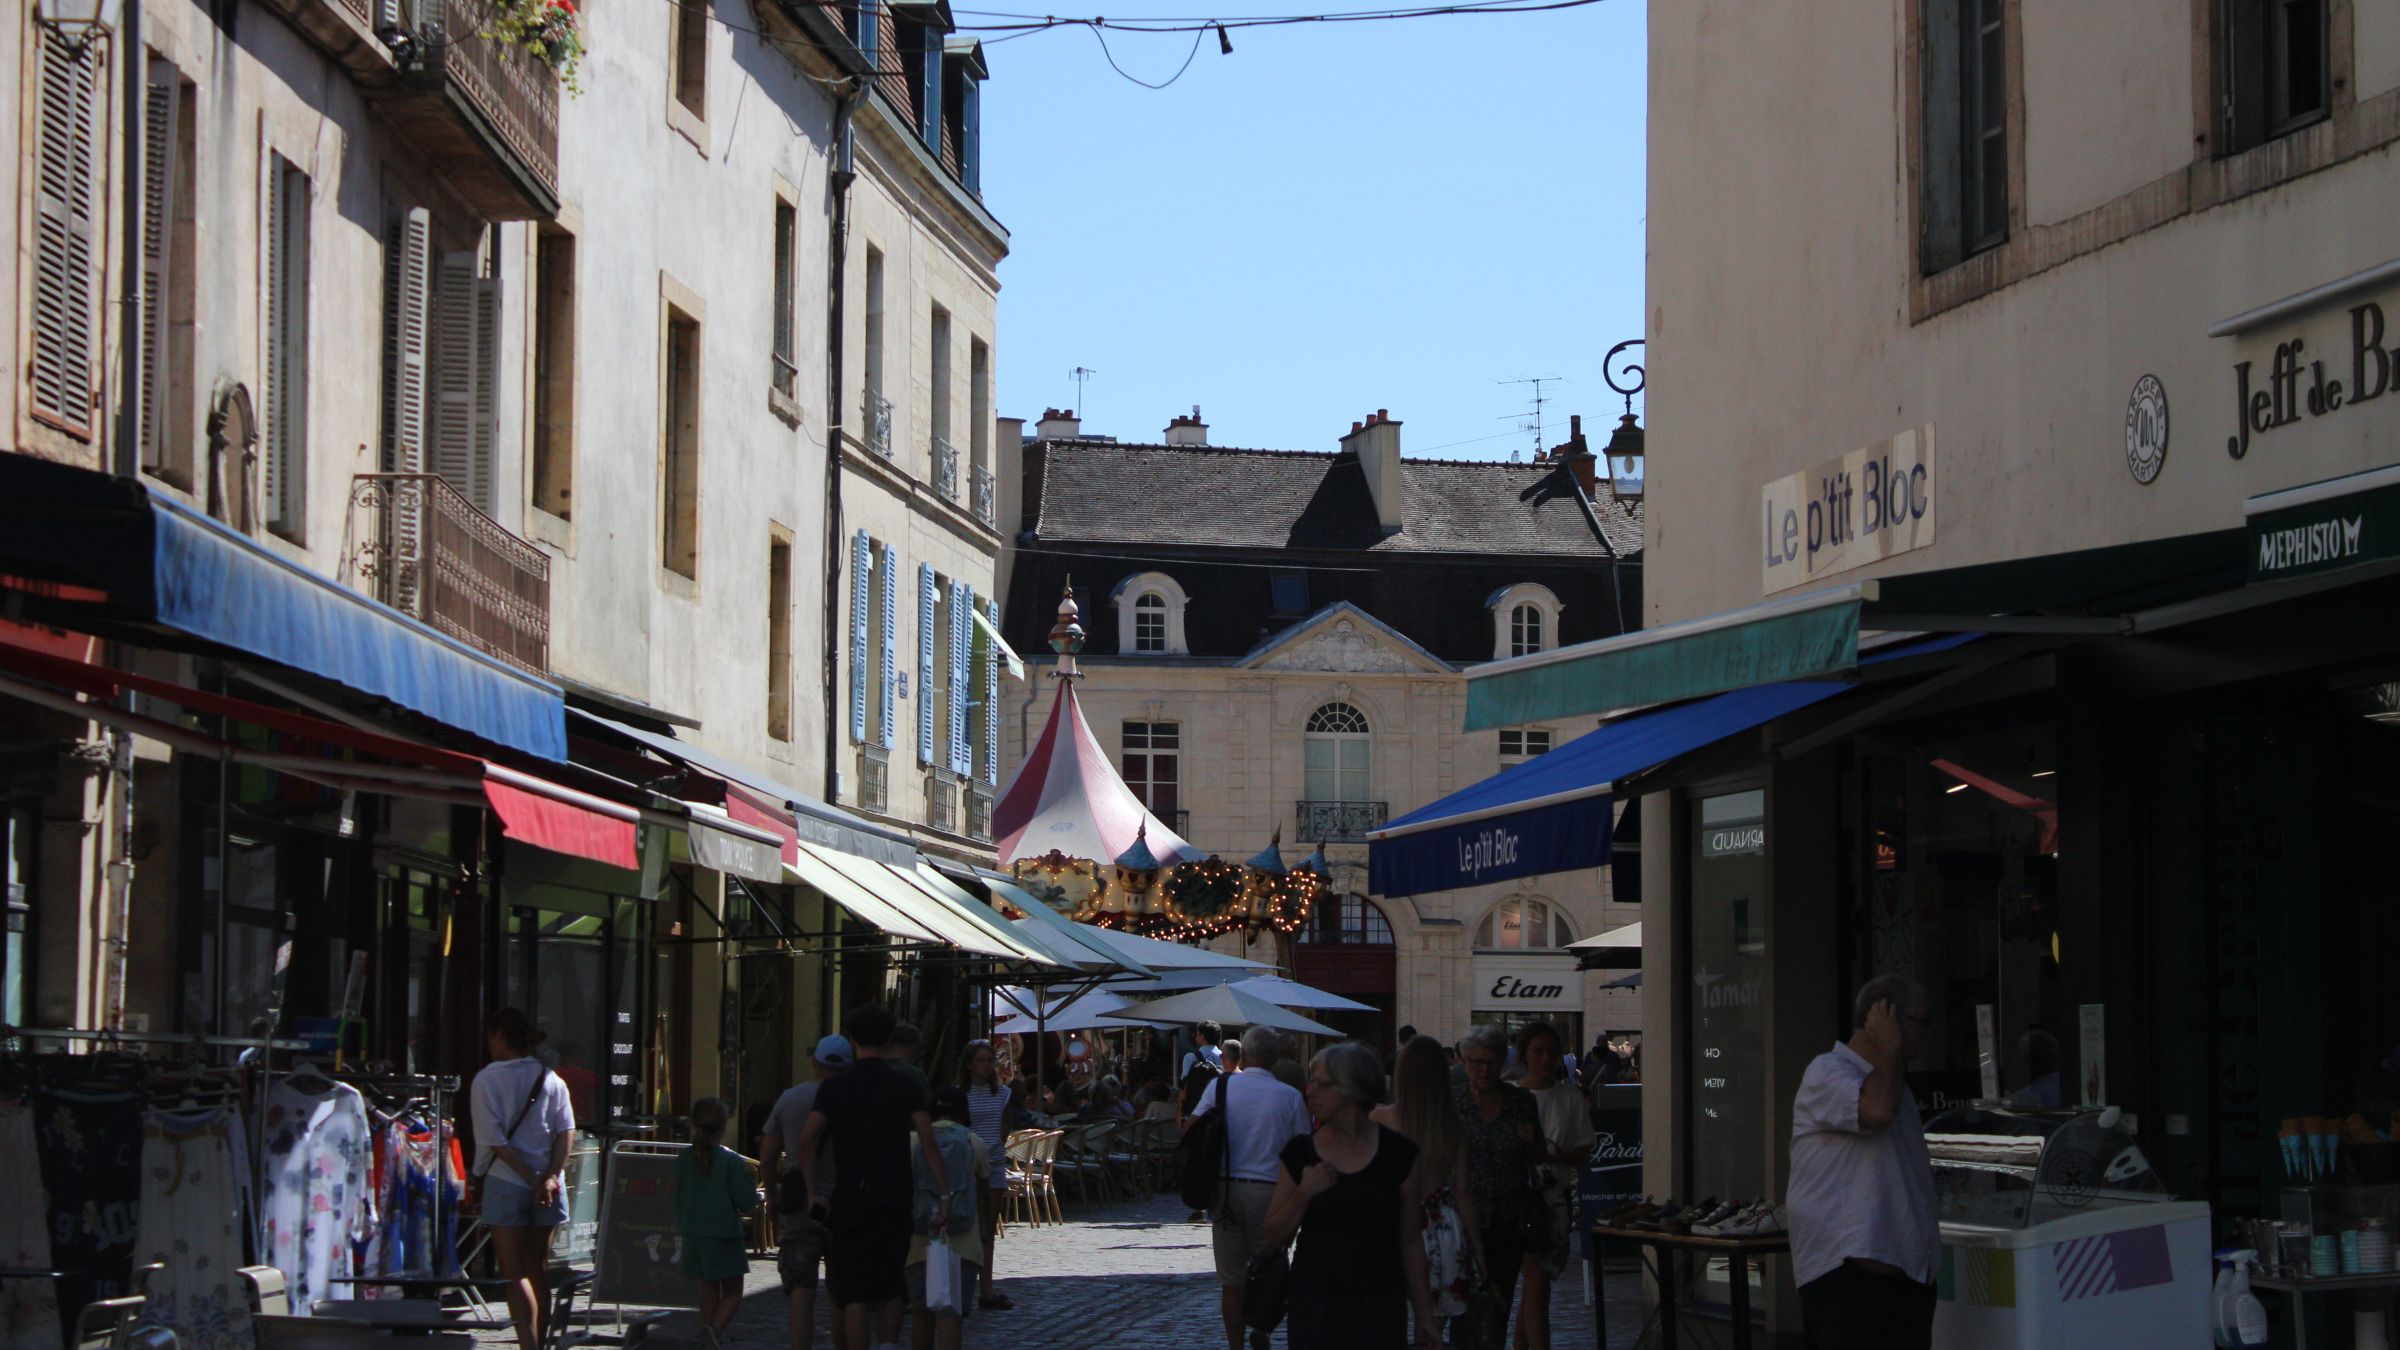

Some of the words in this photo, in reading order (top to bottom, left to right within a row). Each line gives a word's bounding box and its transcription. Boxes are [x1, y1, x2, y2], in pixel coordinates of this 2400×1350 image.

[2227, 337, 2305, 461] Jeff
[2307, 360, 2342, 417] de
[1766, 500, 1798, 568] Le
[1807, 472, 1854, 573] p'tit
[1863, 455, 1928, 536] Bloc
[2259, 518, 2341, 571] MEPHISTO
[1458, 835, 1473, 872] Le
[1474, 831, 1493, 880] p'tit
[1495, 828, 1519, 866] Bloc
[1490, 975, 1563, 998] Etam
